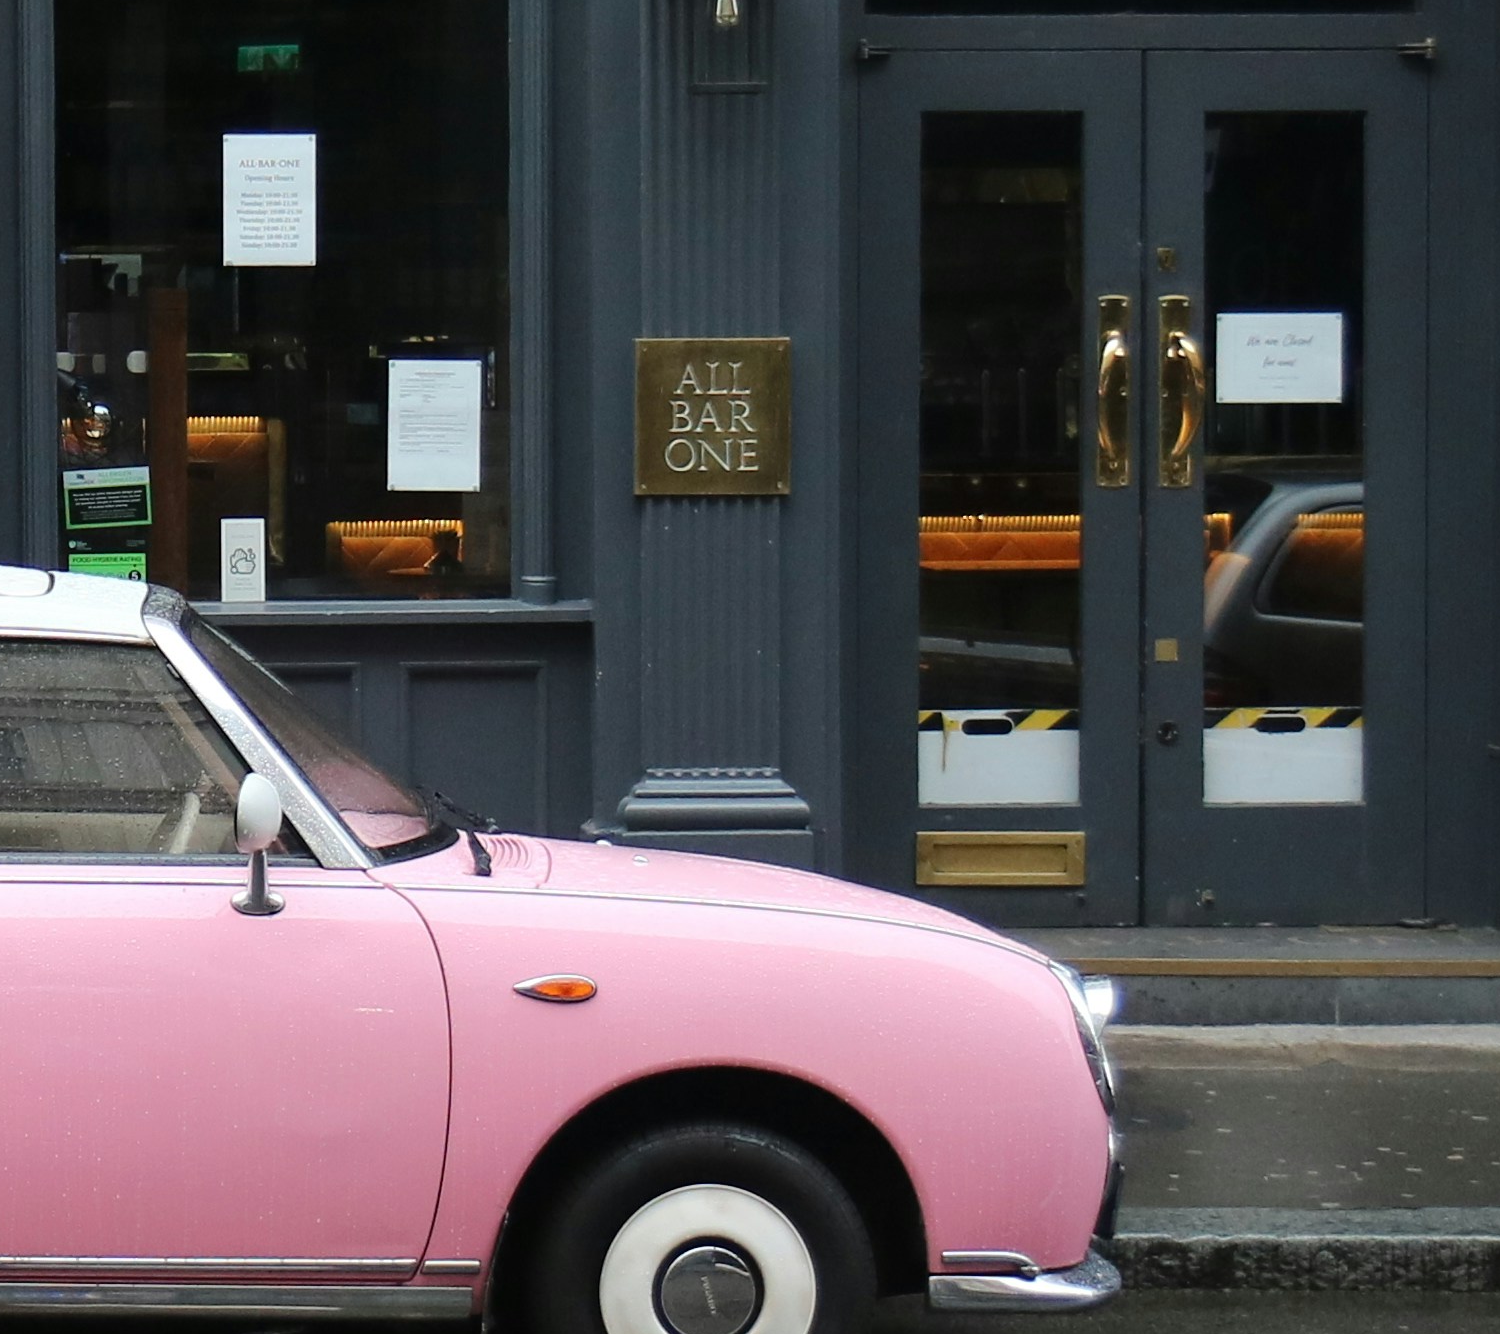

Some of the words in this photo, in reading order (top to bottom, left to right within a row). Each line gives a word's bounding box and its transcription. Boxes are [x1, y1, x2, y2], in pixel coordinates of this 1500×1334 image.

[673, 361, 750, 394] ALL
[669, 400, 758, 432] BAR
[665, 438, 759, 472] ONE
